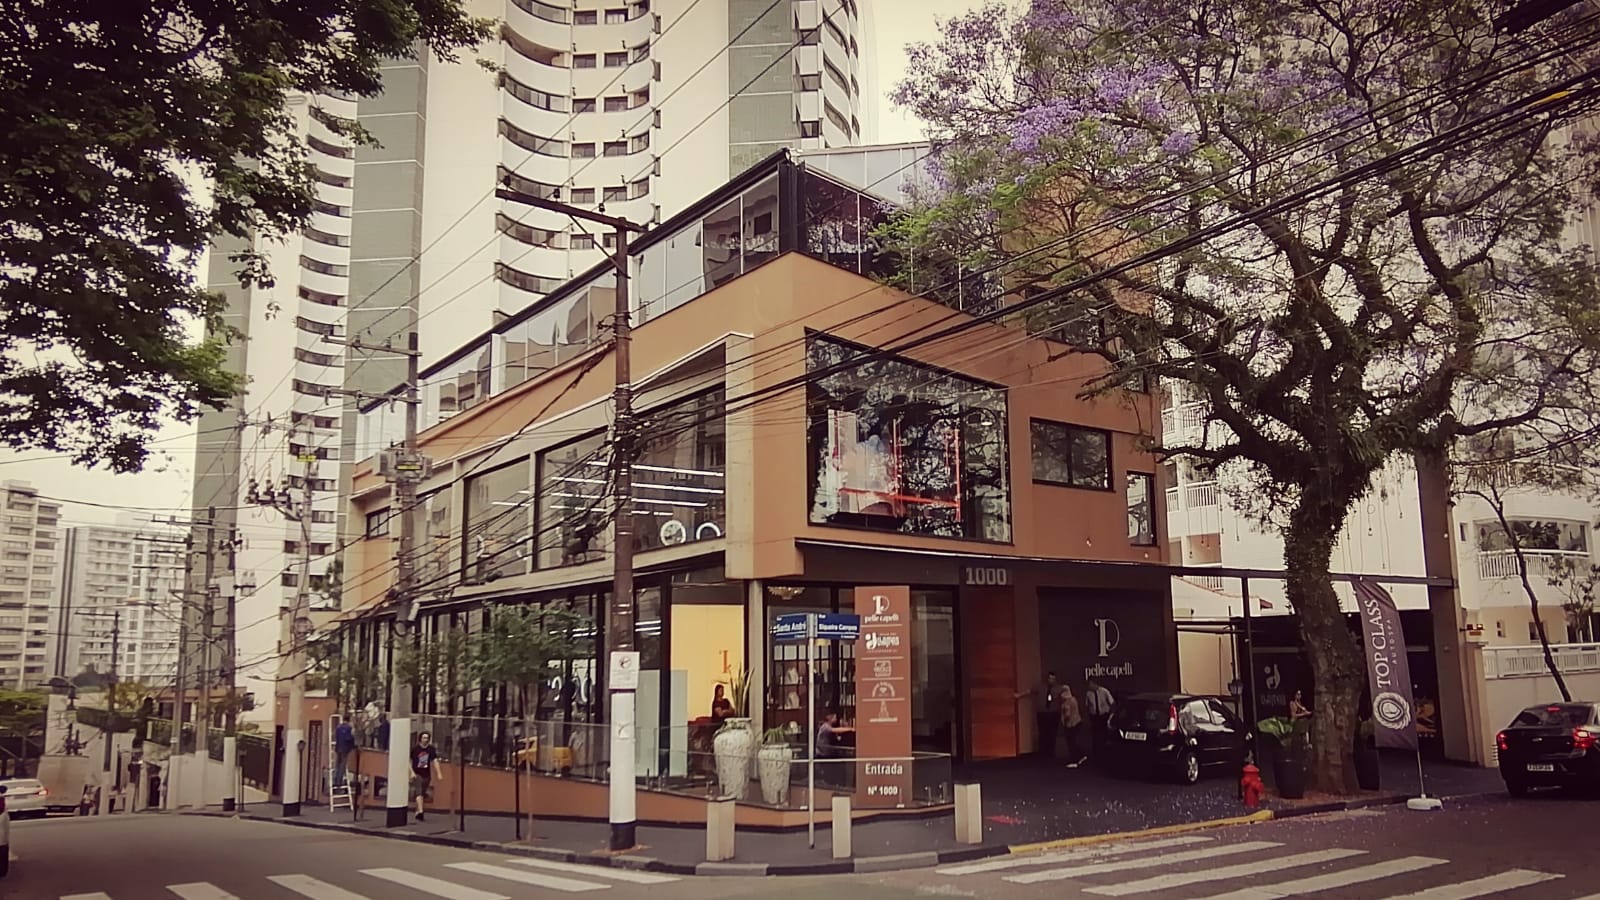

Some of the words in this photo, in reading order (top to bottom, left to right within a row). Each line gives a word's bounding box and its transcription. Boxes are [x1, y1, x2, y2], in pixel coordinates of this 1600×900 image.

[965, 568, 1008, 586] 1000
[1364, 599, 1386, 649] CLASS
[1084, 663, 1105, 680] pelle
[1107, 662, 1133, 680] capelli
[1374, 652, 1391, 688] TOP
[865, 762, 903, 776] Entrada
[879, 785, 898, 795] 1000
